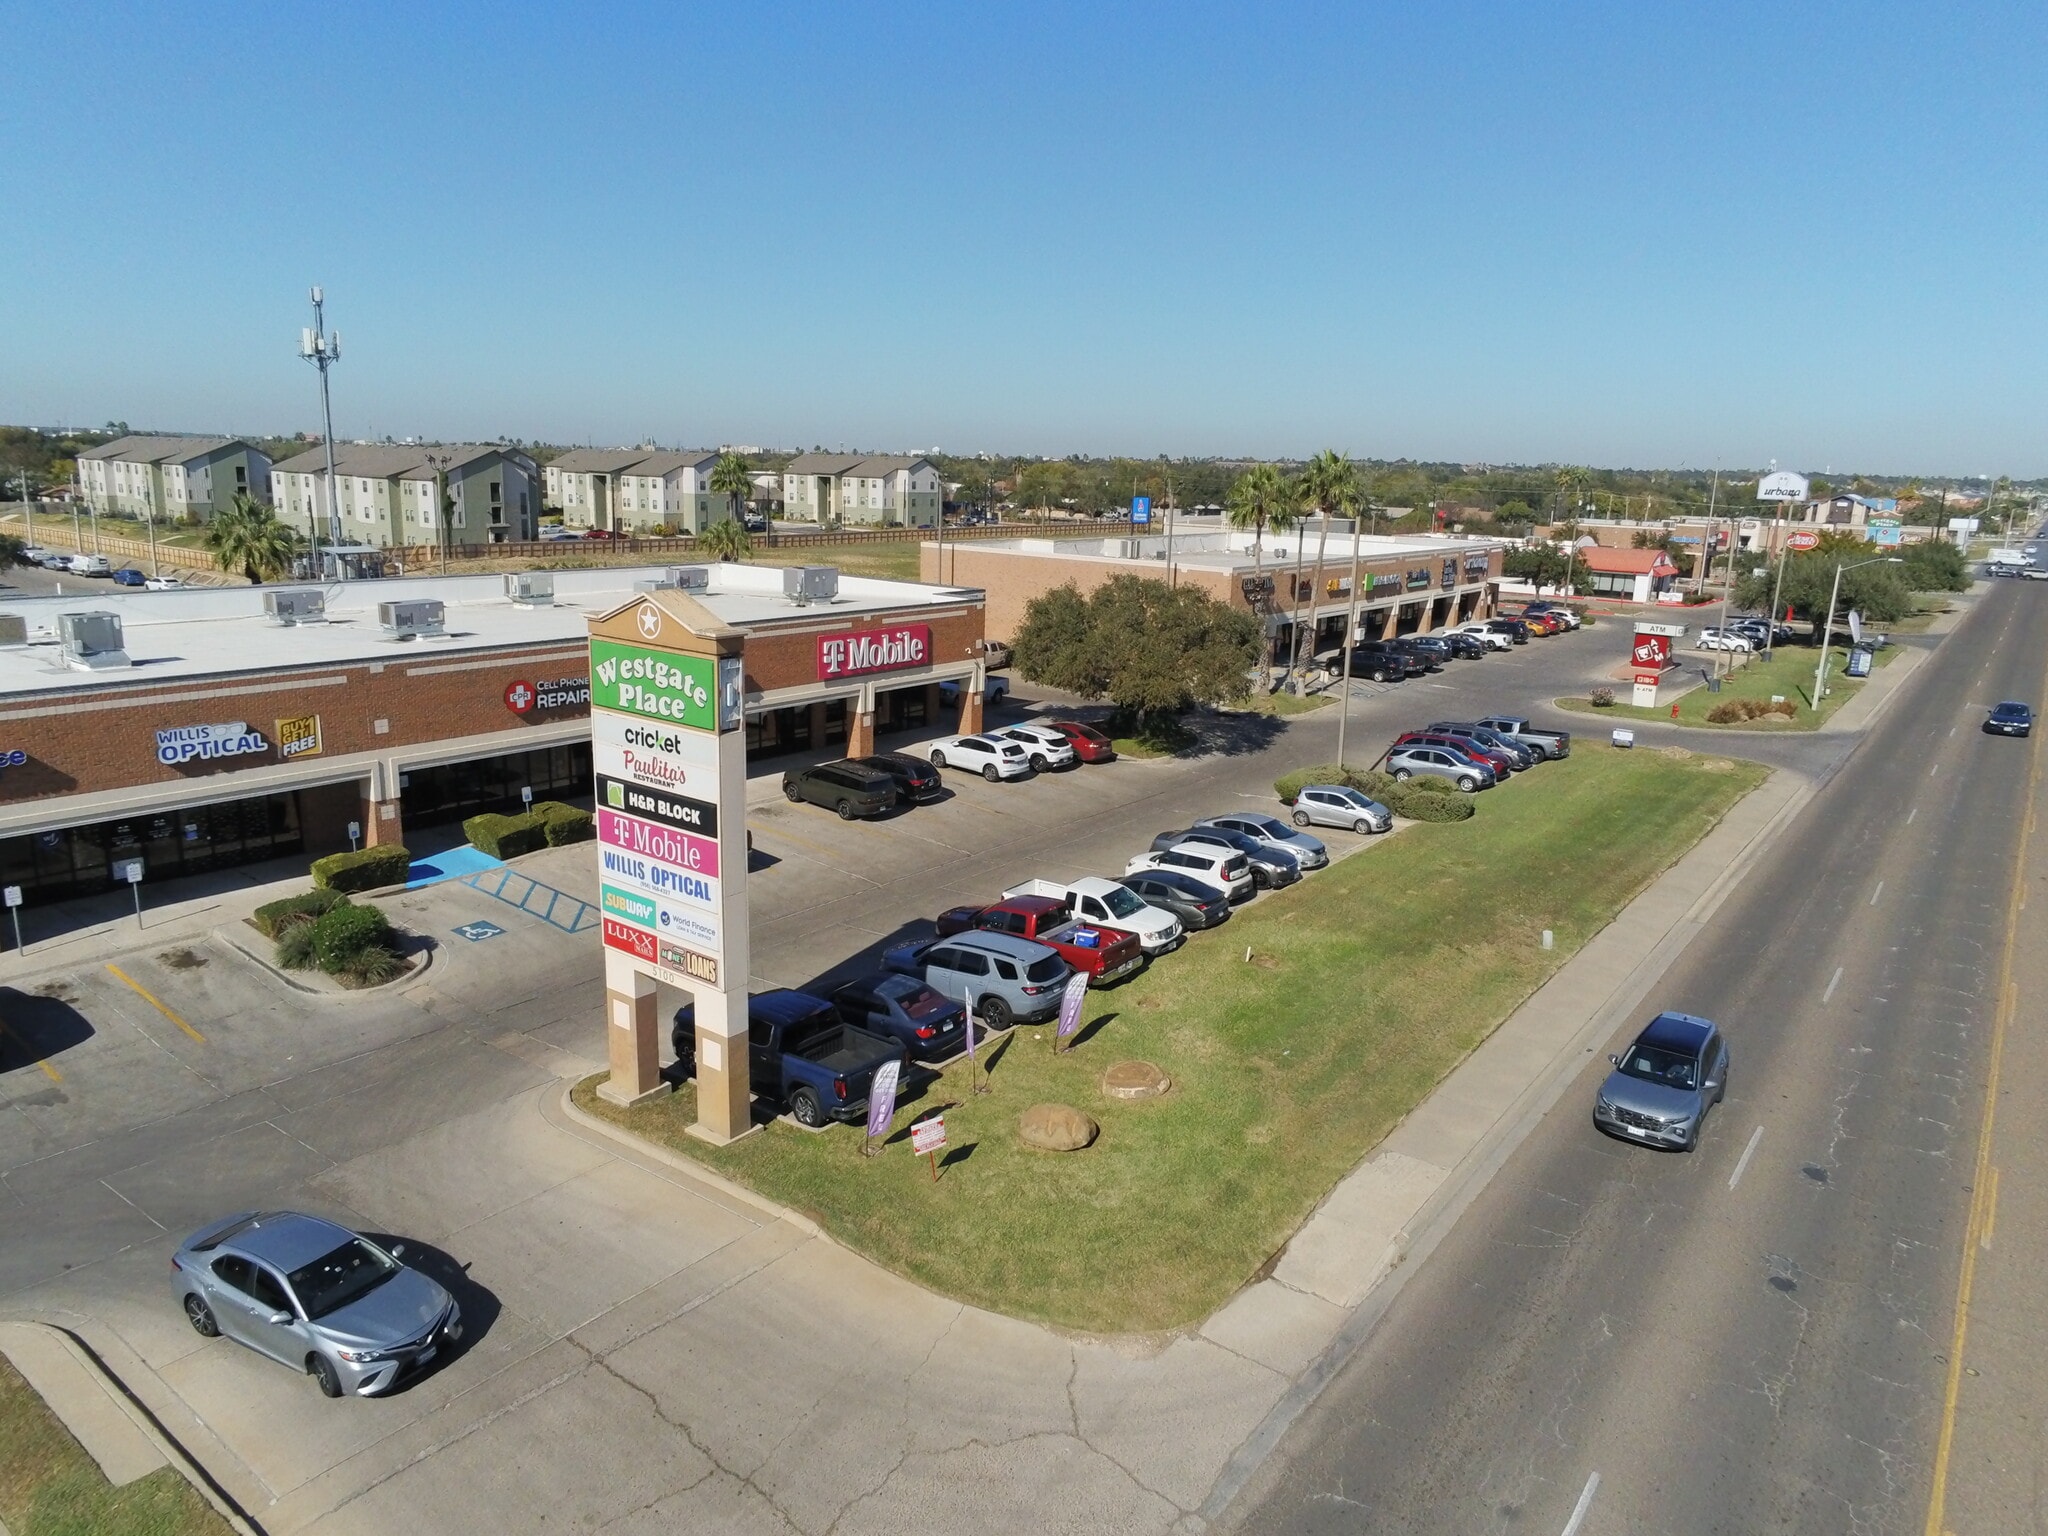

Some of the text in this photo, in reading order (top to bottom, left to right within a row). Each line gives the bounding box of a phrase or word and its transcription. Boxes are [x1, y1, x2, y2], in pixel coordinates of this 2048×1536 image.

[1764, 487, 1800, 496] urbana
[1650, 625, 1666, 633] ATM
[847, 631, 923, 670] Mobile
[1651, 639, 1664, 662] ATM
[537, 677, 589, 691] CELL PHONE
[595, 656, 708, 708] Westgate
[512, 692, 529, 701] CPR
[537, 688, 590, 709] REPAIR
[618, 682, 686, 719] Place
[158, 726, 209, 744] WILLIS
[282, 718, 306, 735] BUY
[282, 728, 306, 744] GET
[161, 734, 265, 761] OPTICAL
[283, 735, 316, 756] FREE
[625, 727, 681, 755] cricket
[623, 750, 686, 784] Paulita's
[633, 773, 675, 789] RESTAURANT
[628, 792, 701, 825] H&R BLOCK
[633, 822, 700, 869] Mobile
[604, 851, 711, 901] WILLIS OPTICAL
[606, 892, 652, 919] SUBWAY
[608, 922, 653, 950] LUXX
[673, 915, 690, 928] World
[692, 922, 716, 936] Finance
[652, 967, 675, 983] 5100
[686, 952, 716, 982] LOANS
